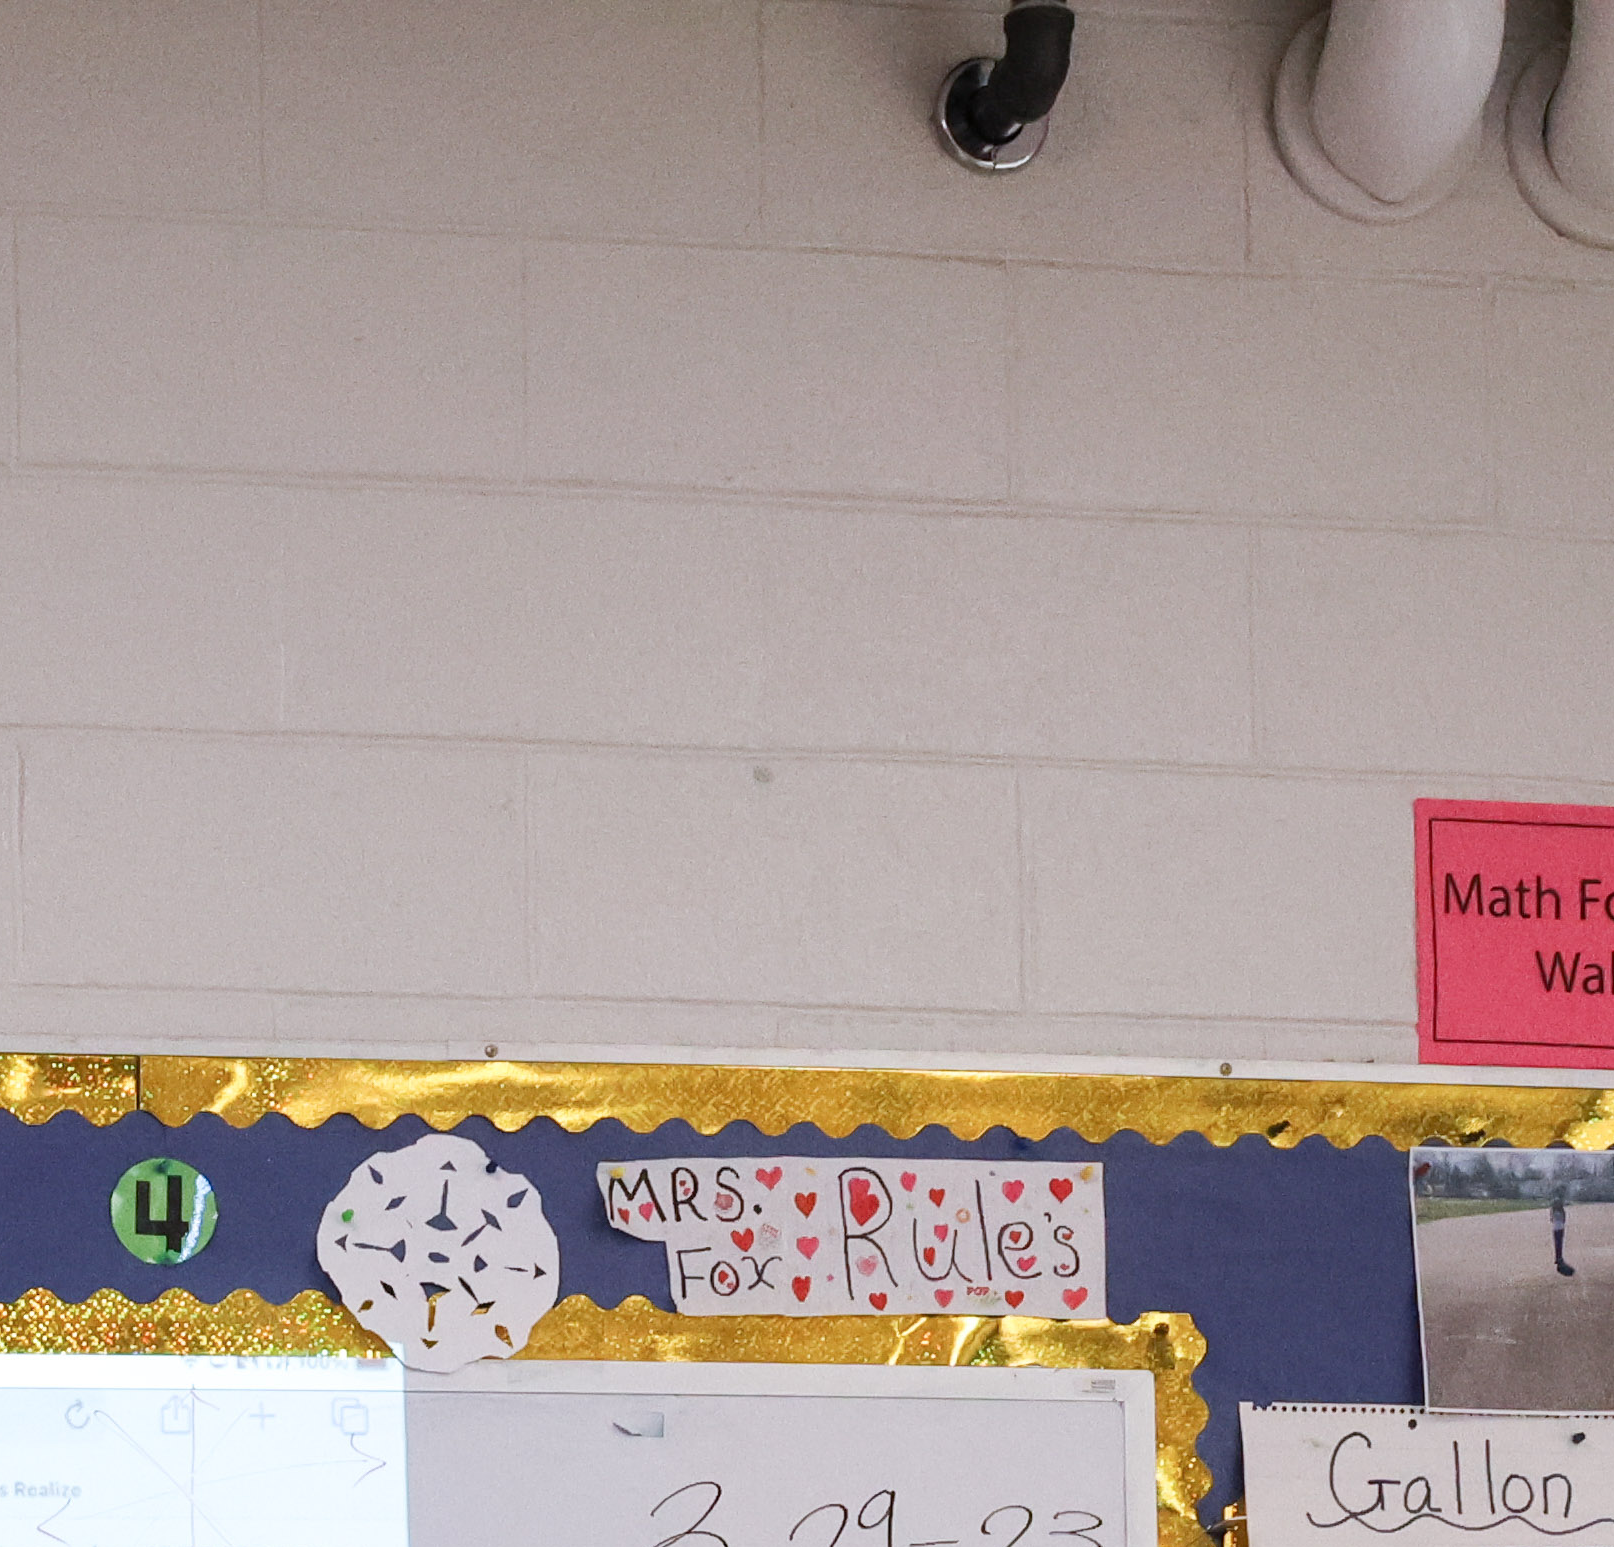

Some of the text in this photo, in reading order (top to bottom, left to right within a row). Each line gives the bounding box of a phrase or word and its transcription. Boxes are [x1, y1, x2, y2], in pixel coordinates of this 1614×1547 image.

[1443, 873, 1562, 920] Math
[132, 1172, 191, 1254] 4
[606, 1165, 763, 1225] MRS.
[13, 1480, 82, 1499] Realize
[1327, 1430, 1574, 1517] Gallon
